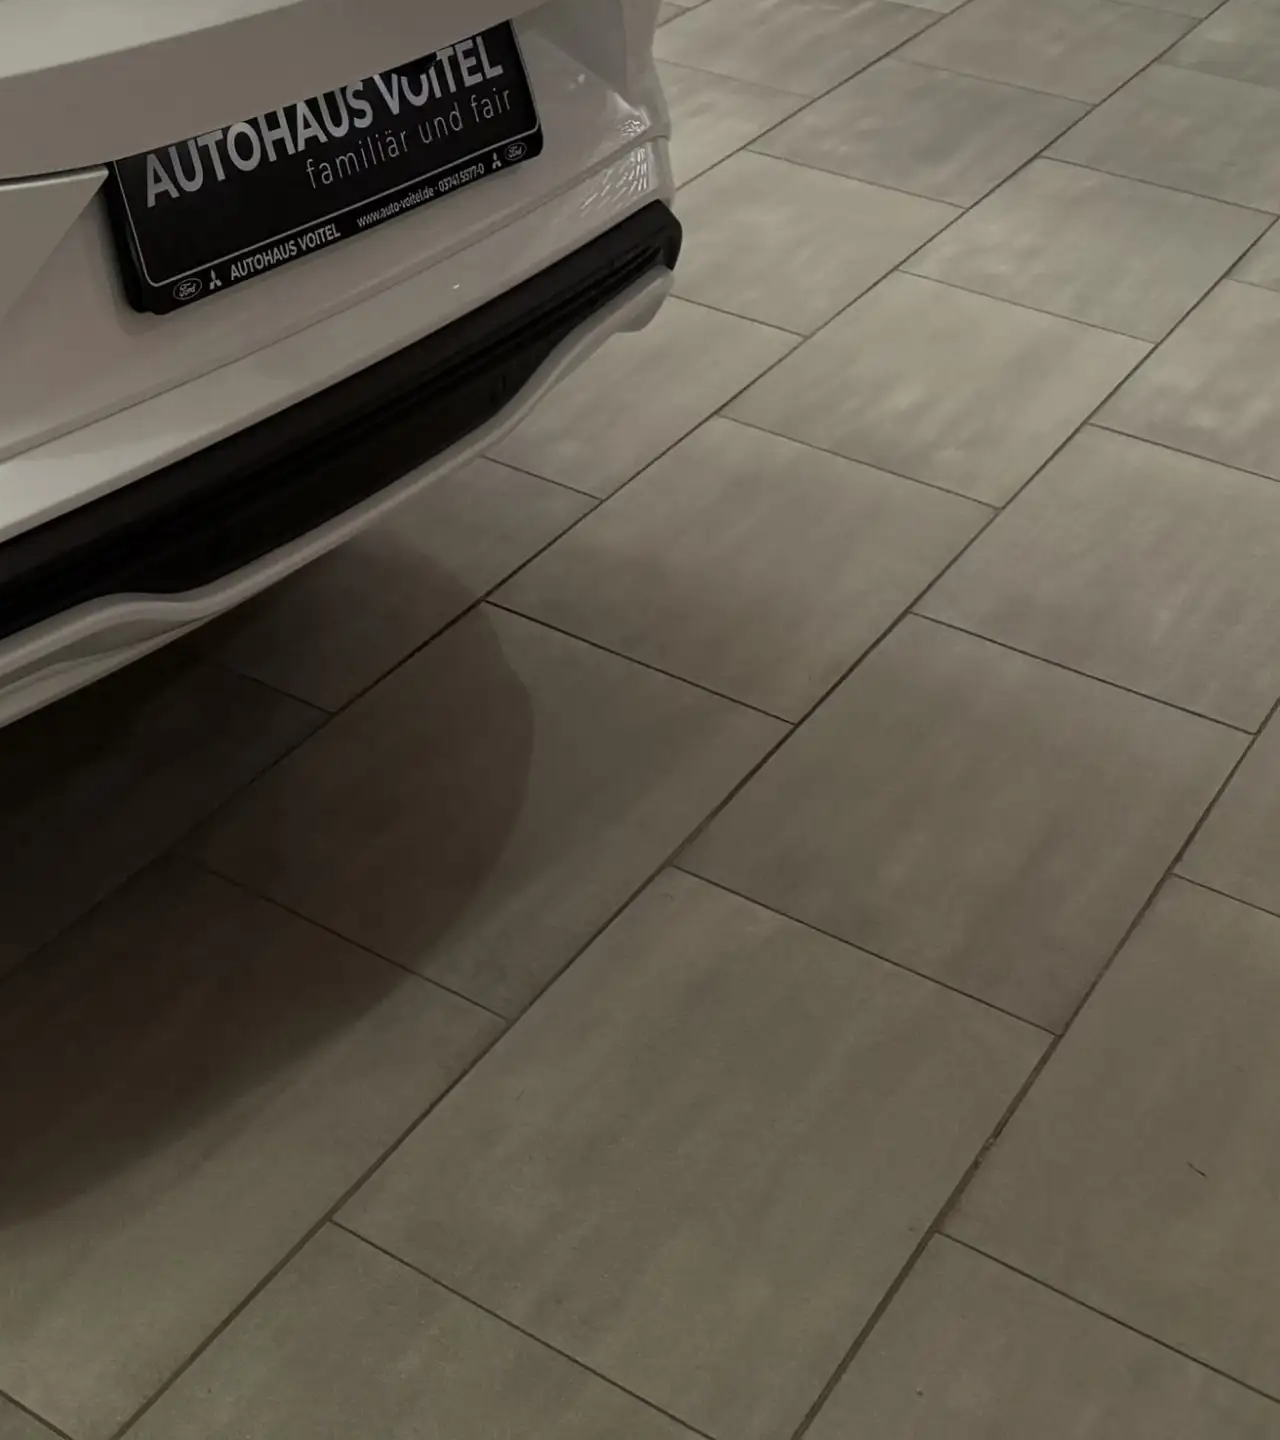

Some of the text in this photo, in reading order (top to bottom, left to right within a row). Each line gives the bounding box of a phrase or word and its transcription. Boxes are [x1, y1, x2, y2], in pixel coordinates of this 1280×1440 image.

[146, 81, 374, 209] AUTOHAUS
[305, 87, 511, 189] familiär und fair
[230, 240, 298, 281] AUTOHAUS
[297, 222, 341, 252] VOITEL
[356, 186, 435, 228] www.auto-voitel.de
